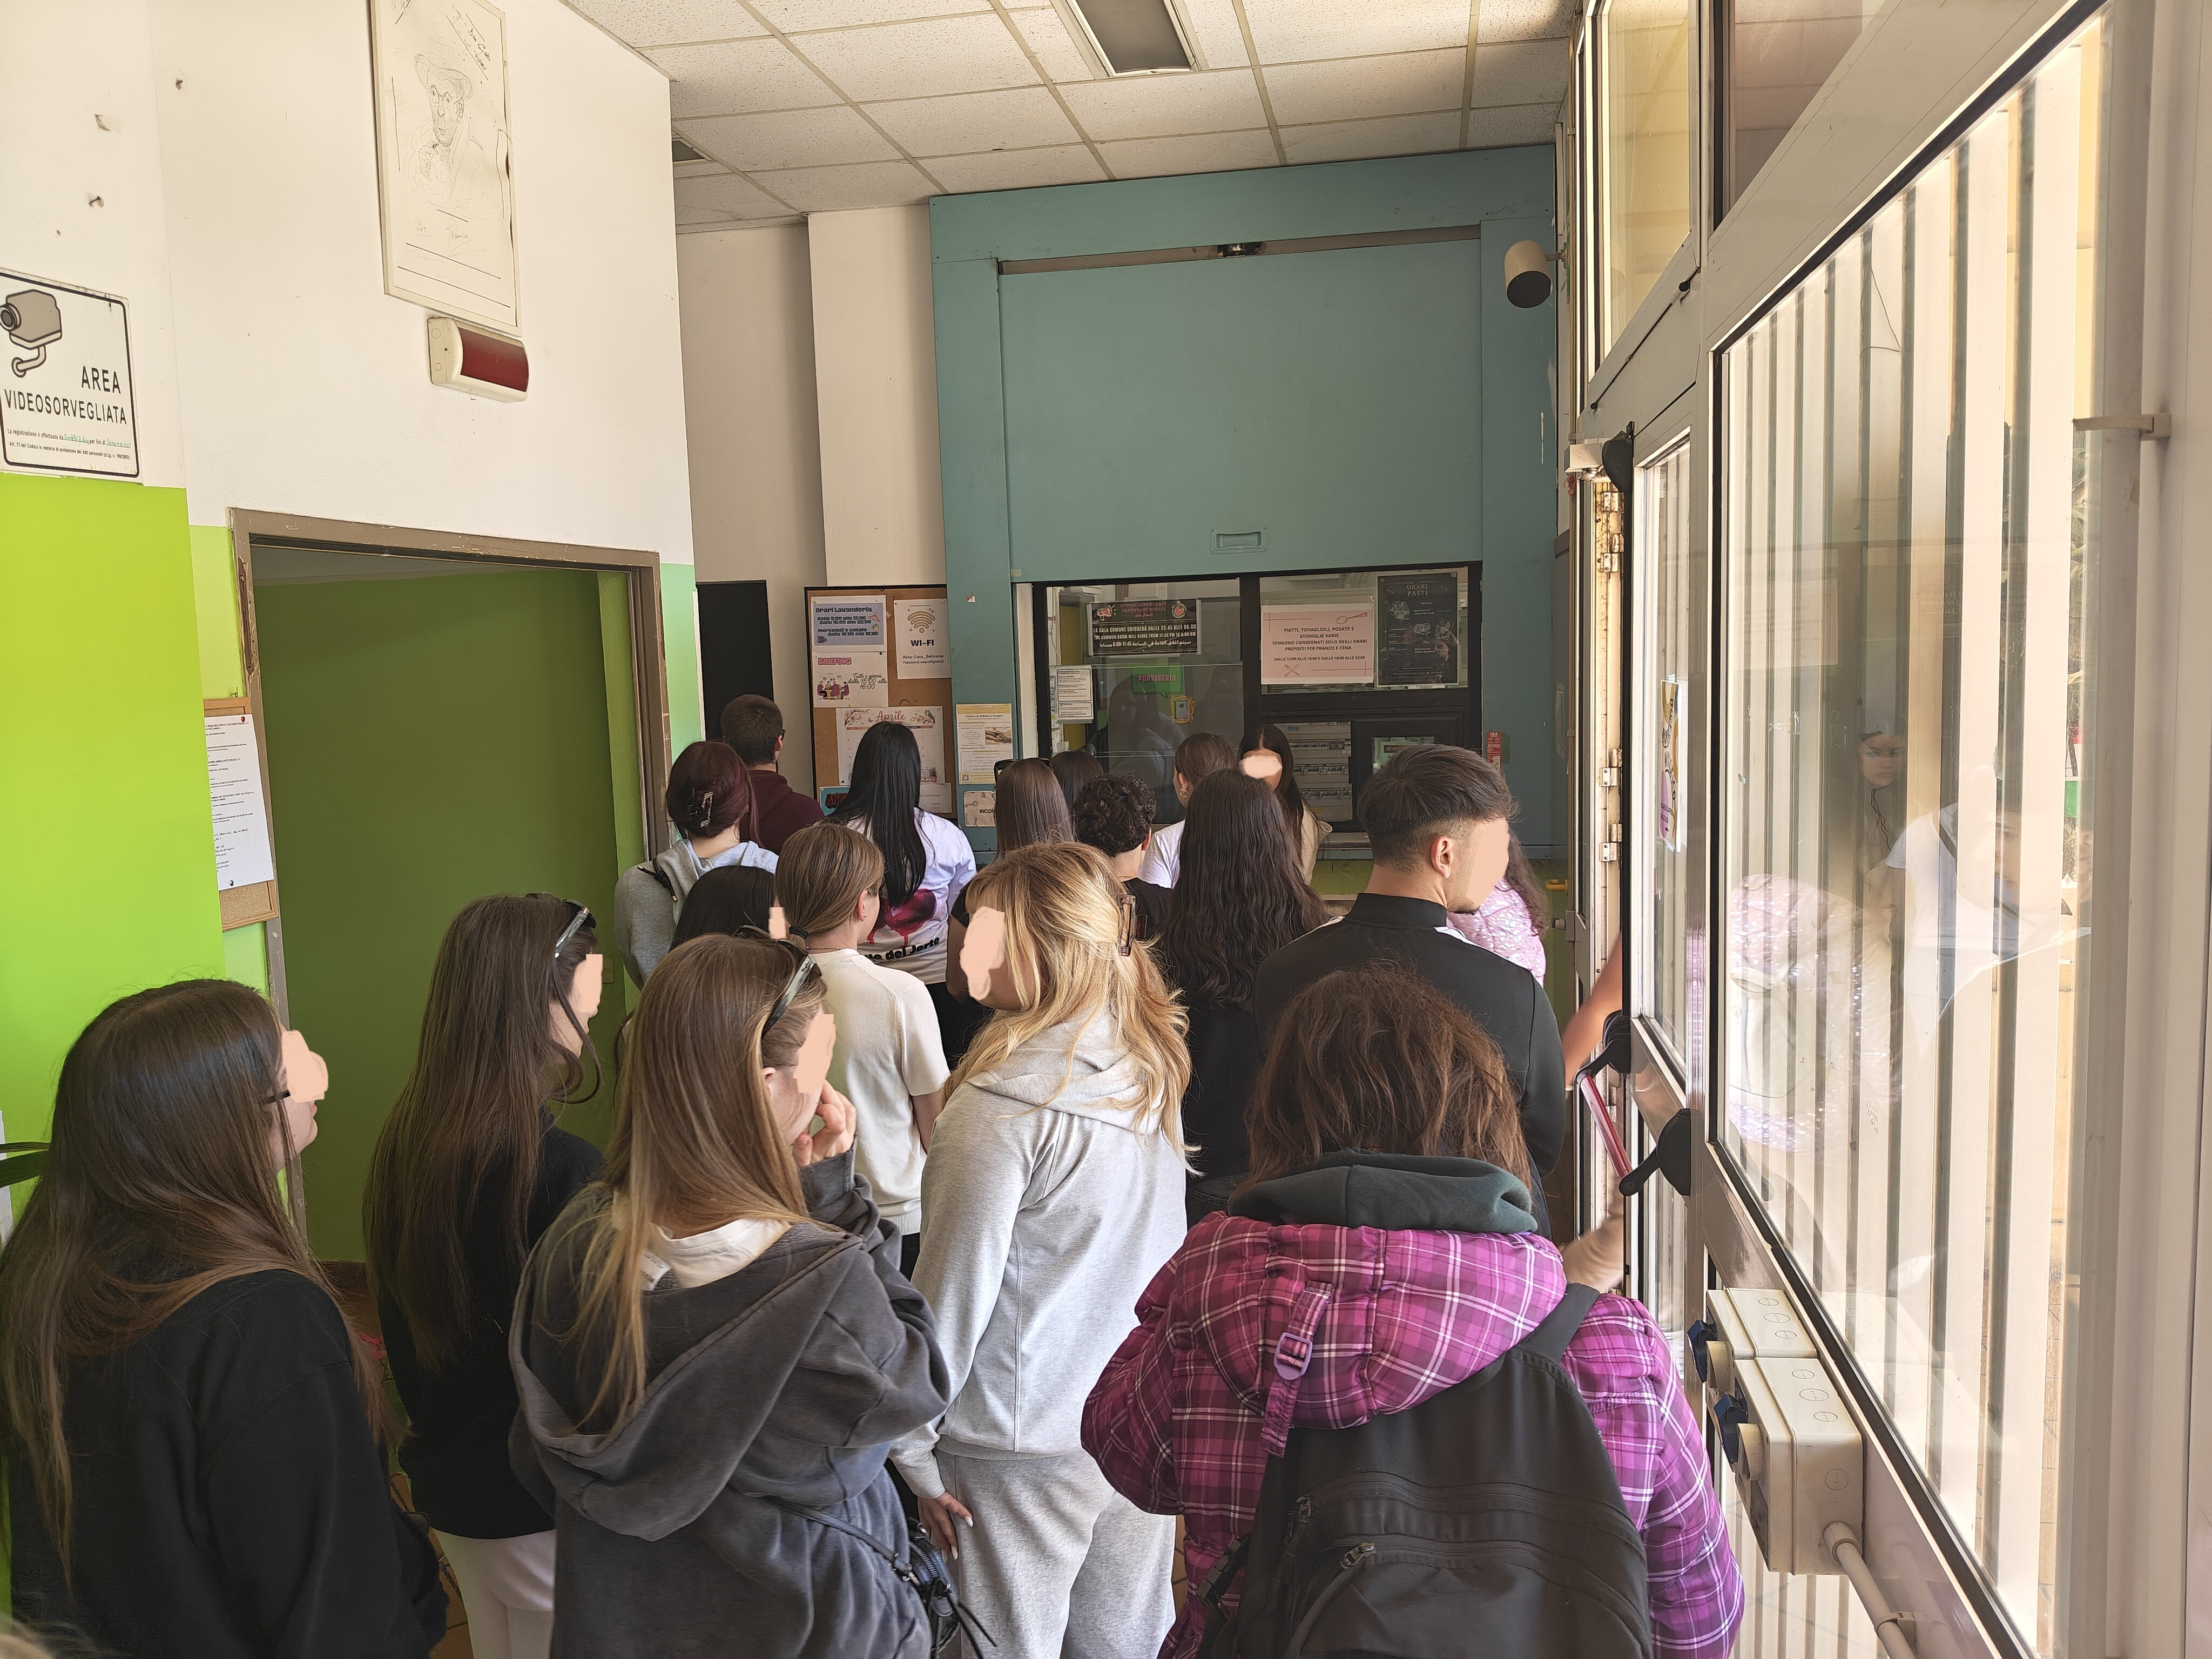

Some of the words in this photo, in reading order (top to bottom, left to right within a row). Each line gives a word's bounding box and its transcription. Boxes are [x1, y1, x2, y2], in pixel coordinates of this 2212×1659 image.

[82, 366, 121, 394] AREA
[4, 389, 127, 425] VIDEOSORVEGLIATA
[875, 710, 906, 723] Aprile
